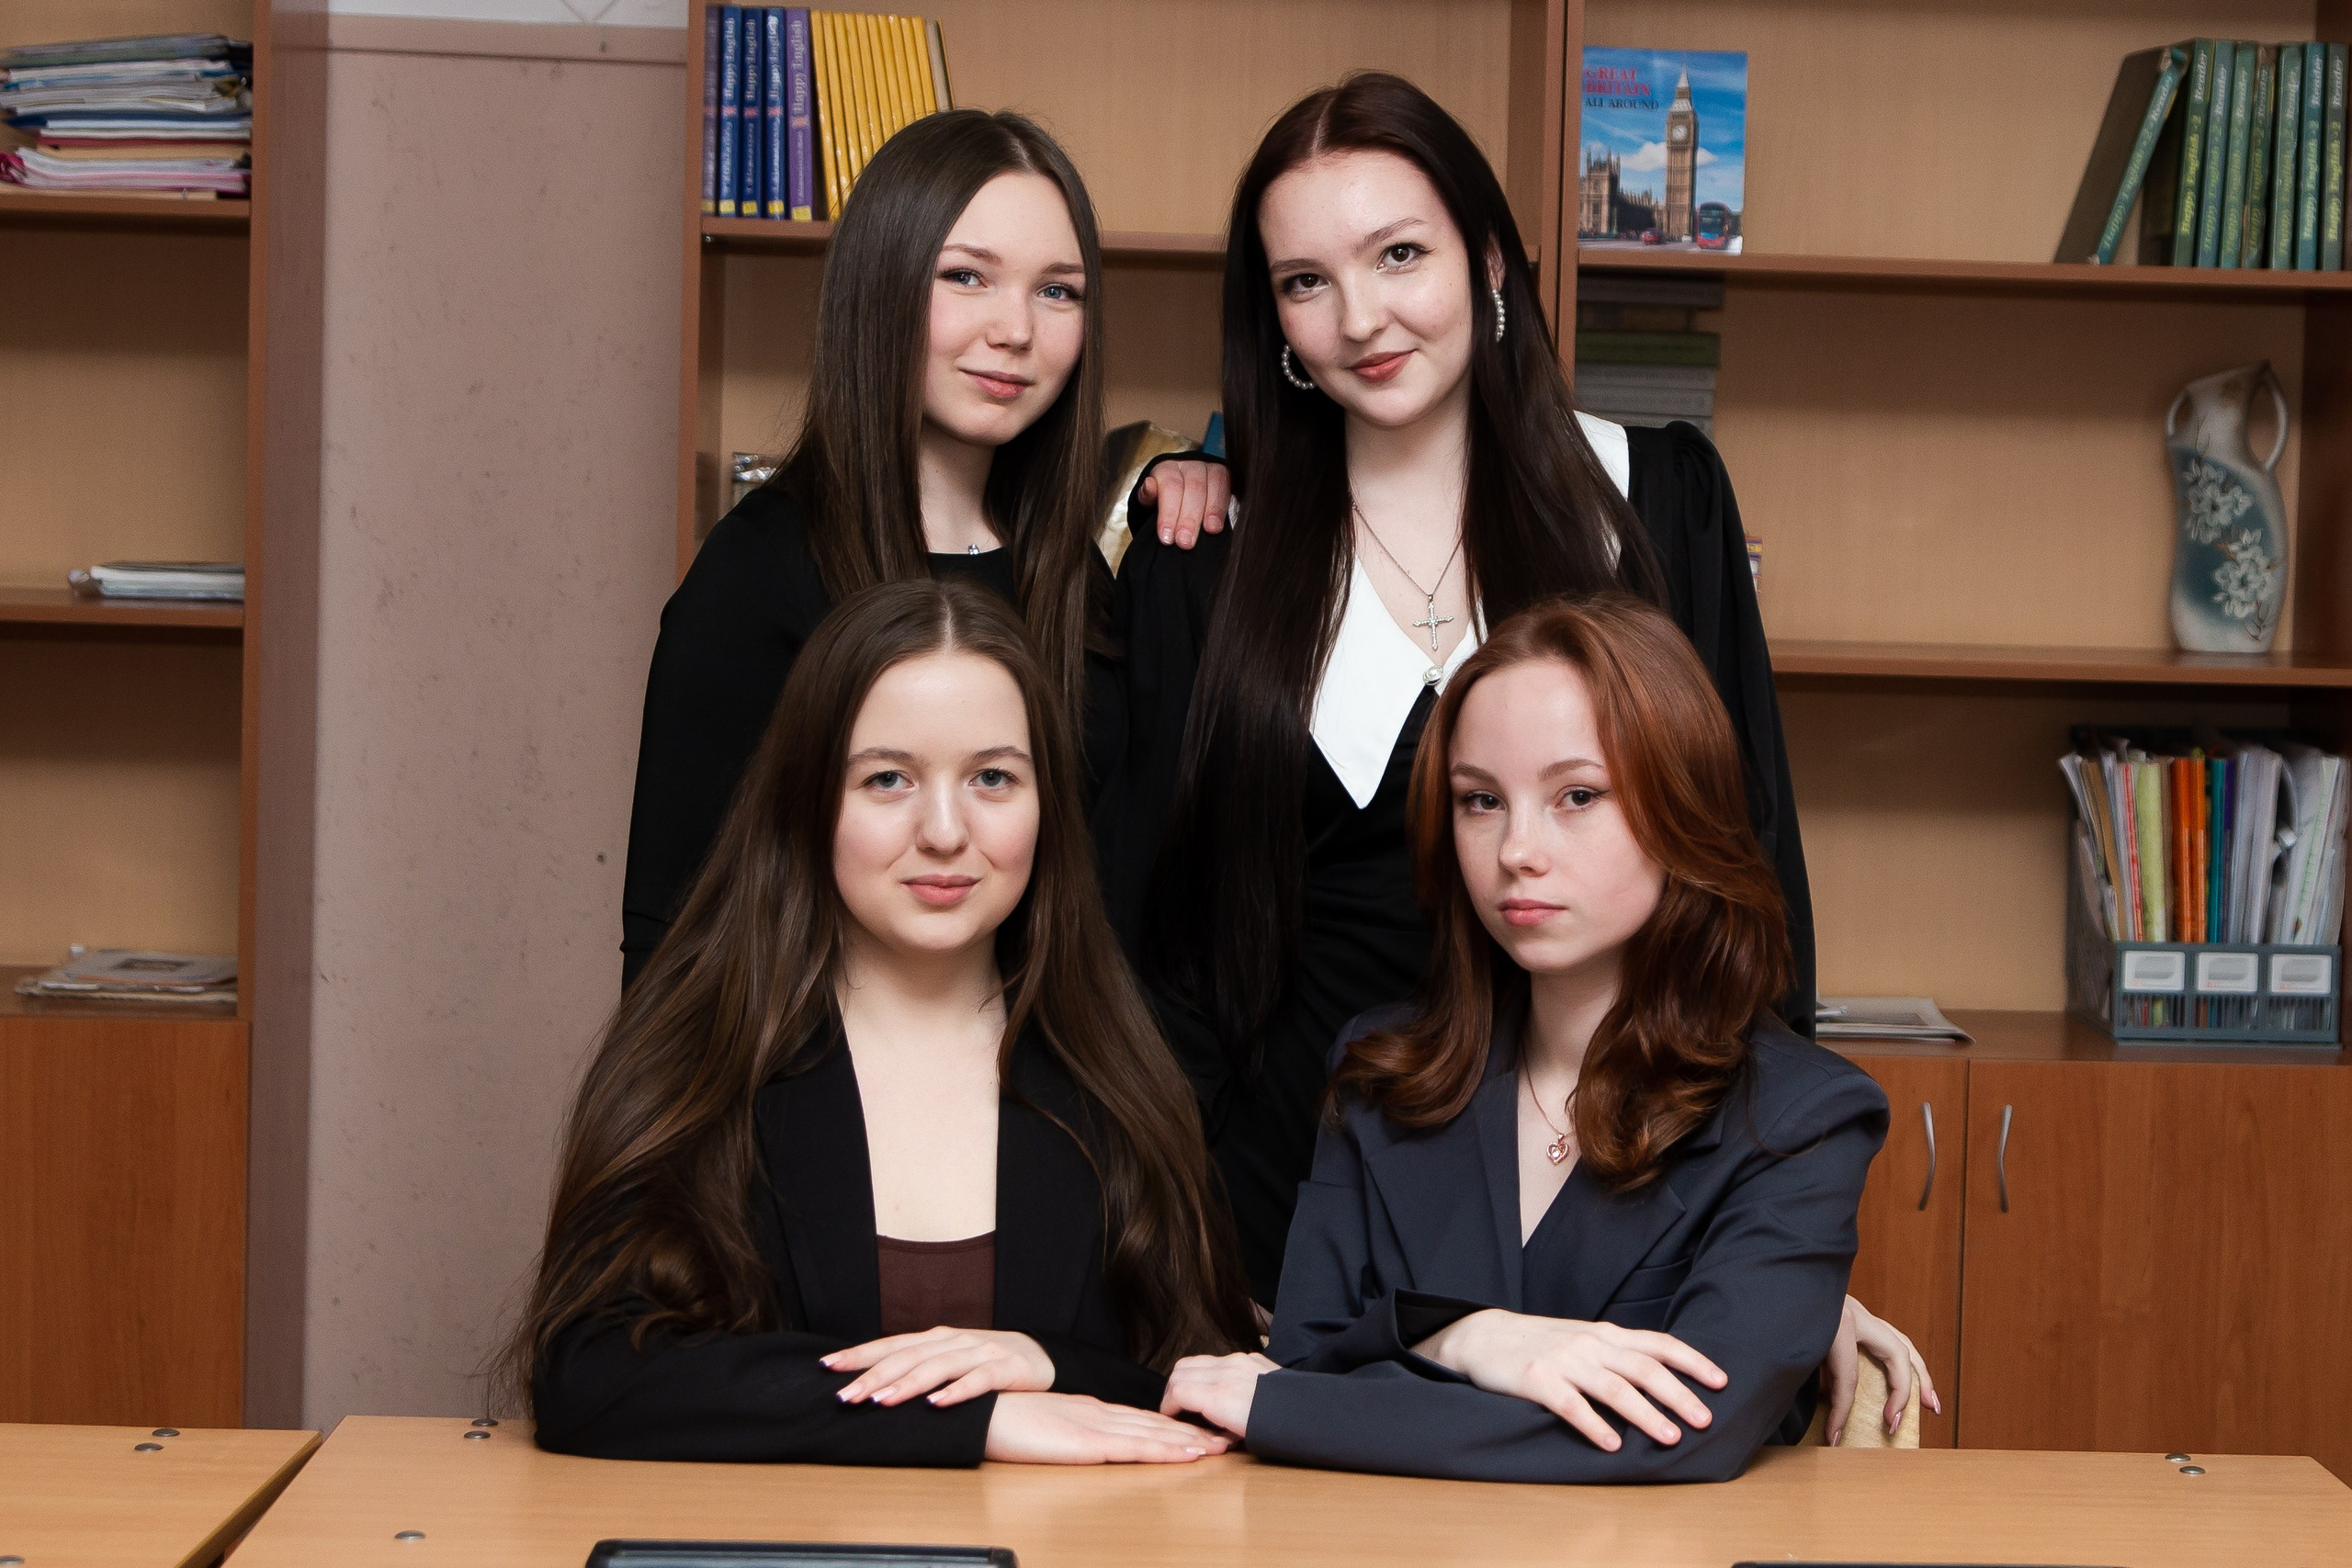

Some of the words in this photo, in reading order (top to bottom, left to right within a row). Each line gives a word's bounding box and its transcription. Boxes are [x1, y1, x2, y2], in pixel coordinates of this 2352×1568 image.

[725, 17, 736, 60] English
[747, 18, 756, 62] English
[792, 20, 805, 68] English
[724, 63, 736, 99] Happy
[746, 64, 757, 100] Happy
[770, 64, 780, 99] Happy
[794, 71, 806, 113] Happy
[1585, 66, 1638, 80] GREAT
[1585, 80, 1650, 96] BRITAIN
[2196, 50, 2208, 101] Reader
[2312, 55, 2323, 106] Reader
[2334, 56, 2344, 107] Reader
[1608, 97, 1659, 109] AROUND
[2186, 132, 2201, 185] English
[2306, 138, 2319, 190] English
[2331, 140, 2343, 192] English
[2181, 187, 2196, 233] Happy
[2303, 193, 2316, 240] Happy
[2329, 197, 2341, 241] Happy
